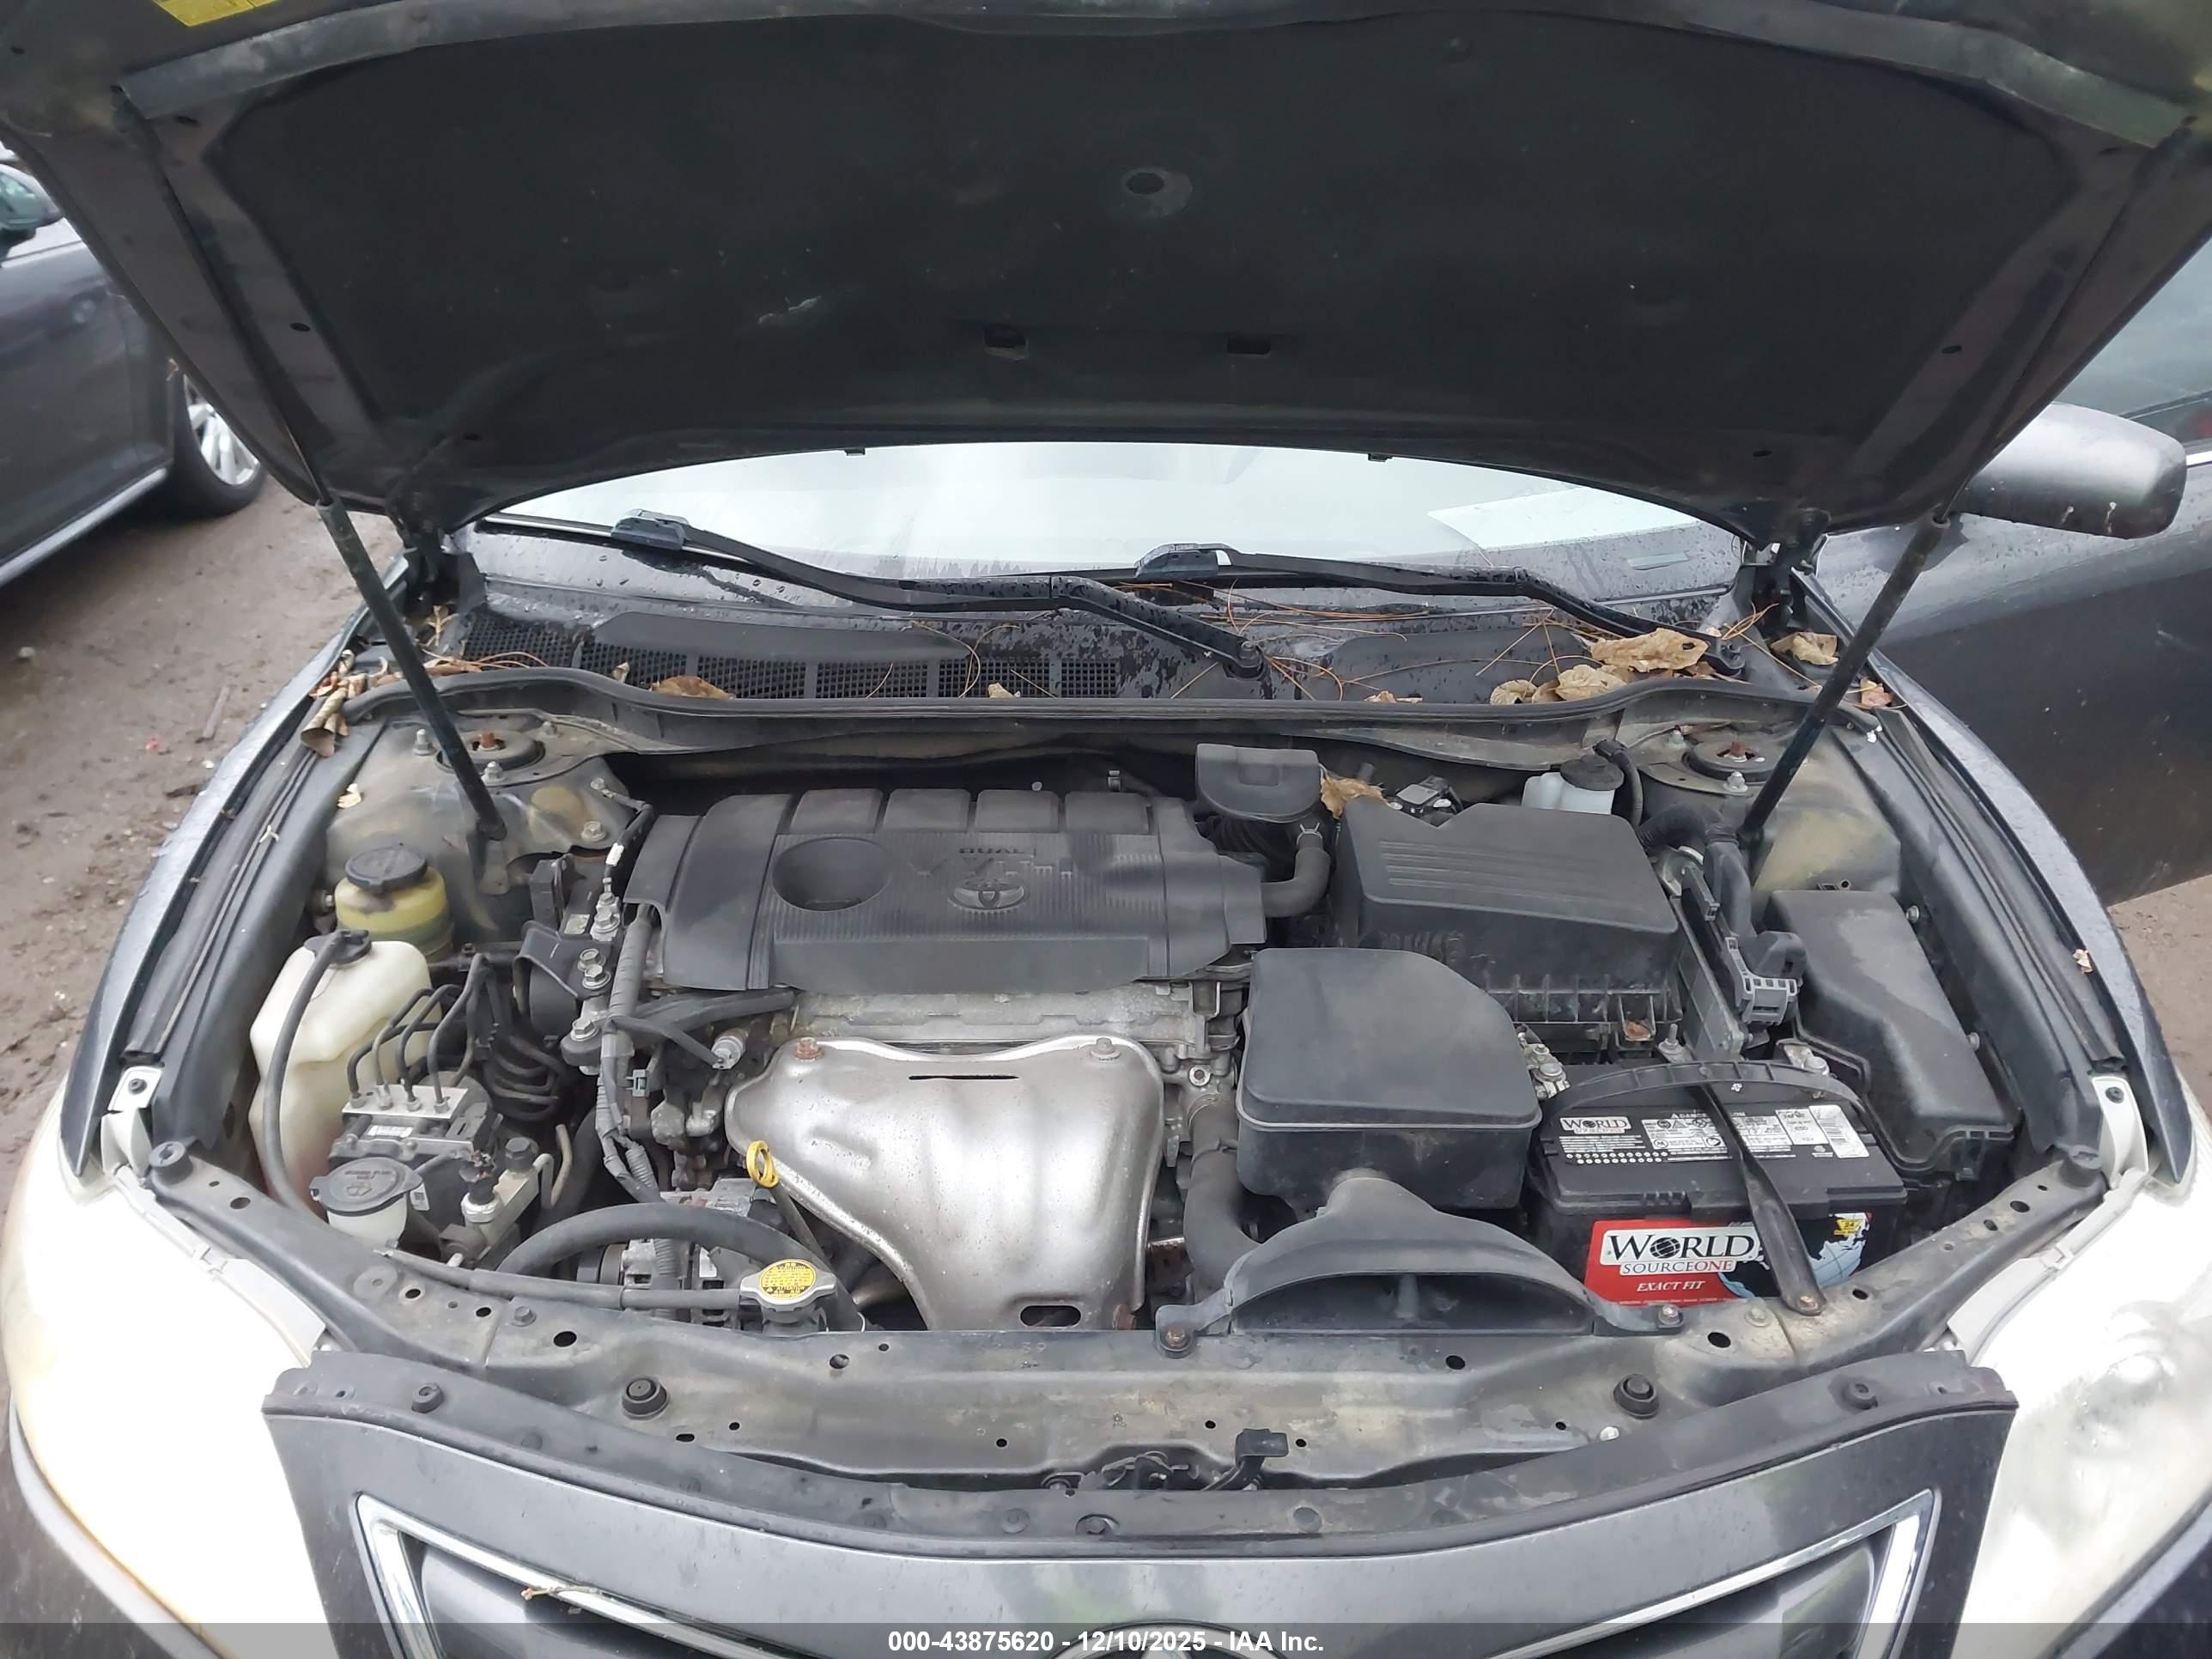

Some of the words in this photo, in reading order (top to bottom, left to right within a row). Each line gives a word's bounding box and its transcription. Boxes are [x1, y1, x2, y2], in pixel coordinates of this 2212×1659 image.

[1563, 1119, 1627, 1128] WORLD
[1607, 1234, 1755, 1261] WORLD
[1622, 1260, 1734, 1274] SOURCEONE
[1637, 1281, 1682, 1292] EXACT
[1683, 1280, 1707, 1290] FIT
